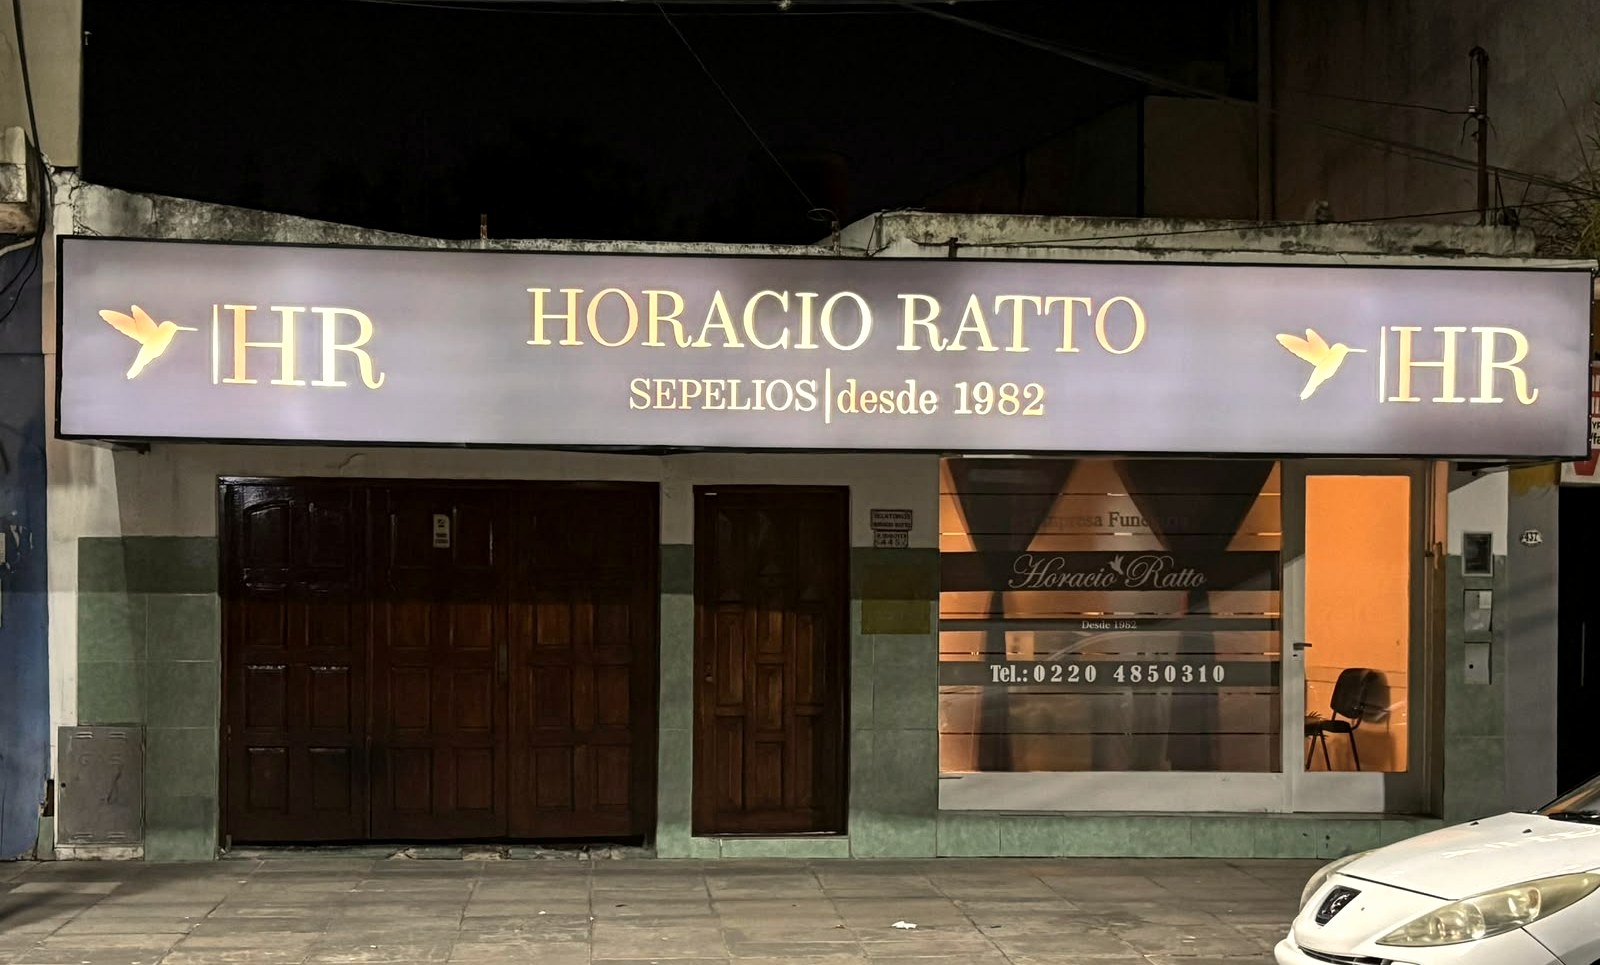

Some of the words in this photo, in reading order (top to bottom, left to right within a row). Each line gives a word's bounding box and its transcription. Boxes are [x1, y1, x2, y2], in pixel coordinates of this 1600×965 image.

[526, 287, 872, 352] HORACIO
[896, 293, 1148, 355] RATTO
[222, 303, 386, 390] HR
[1388, 325, 1539, 405] HR
[628, 377, 818, 412] SEPELIOS
[835, 377, 938, 415] desde
[953, 380, 1046, 416] 1982
[1008, 554, 1118, 589] Horacio
[1124, 555, 1207, 588] Ratto
[1081, 620, 1110, 630] Desde
[990, 664, 1028, 683] Tel.:
[1033, 664, 1097, 683] 0220
[1113, 664, 1226, 683] 4850310
